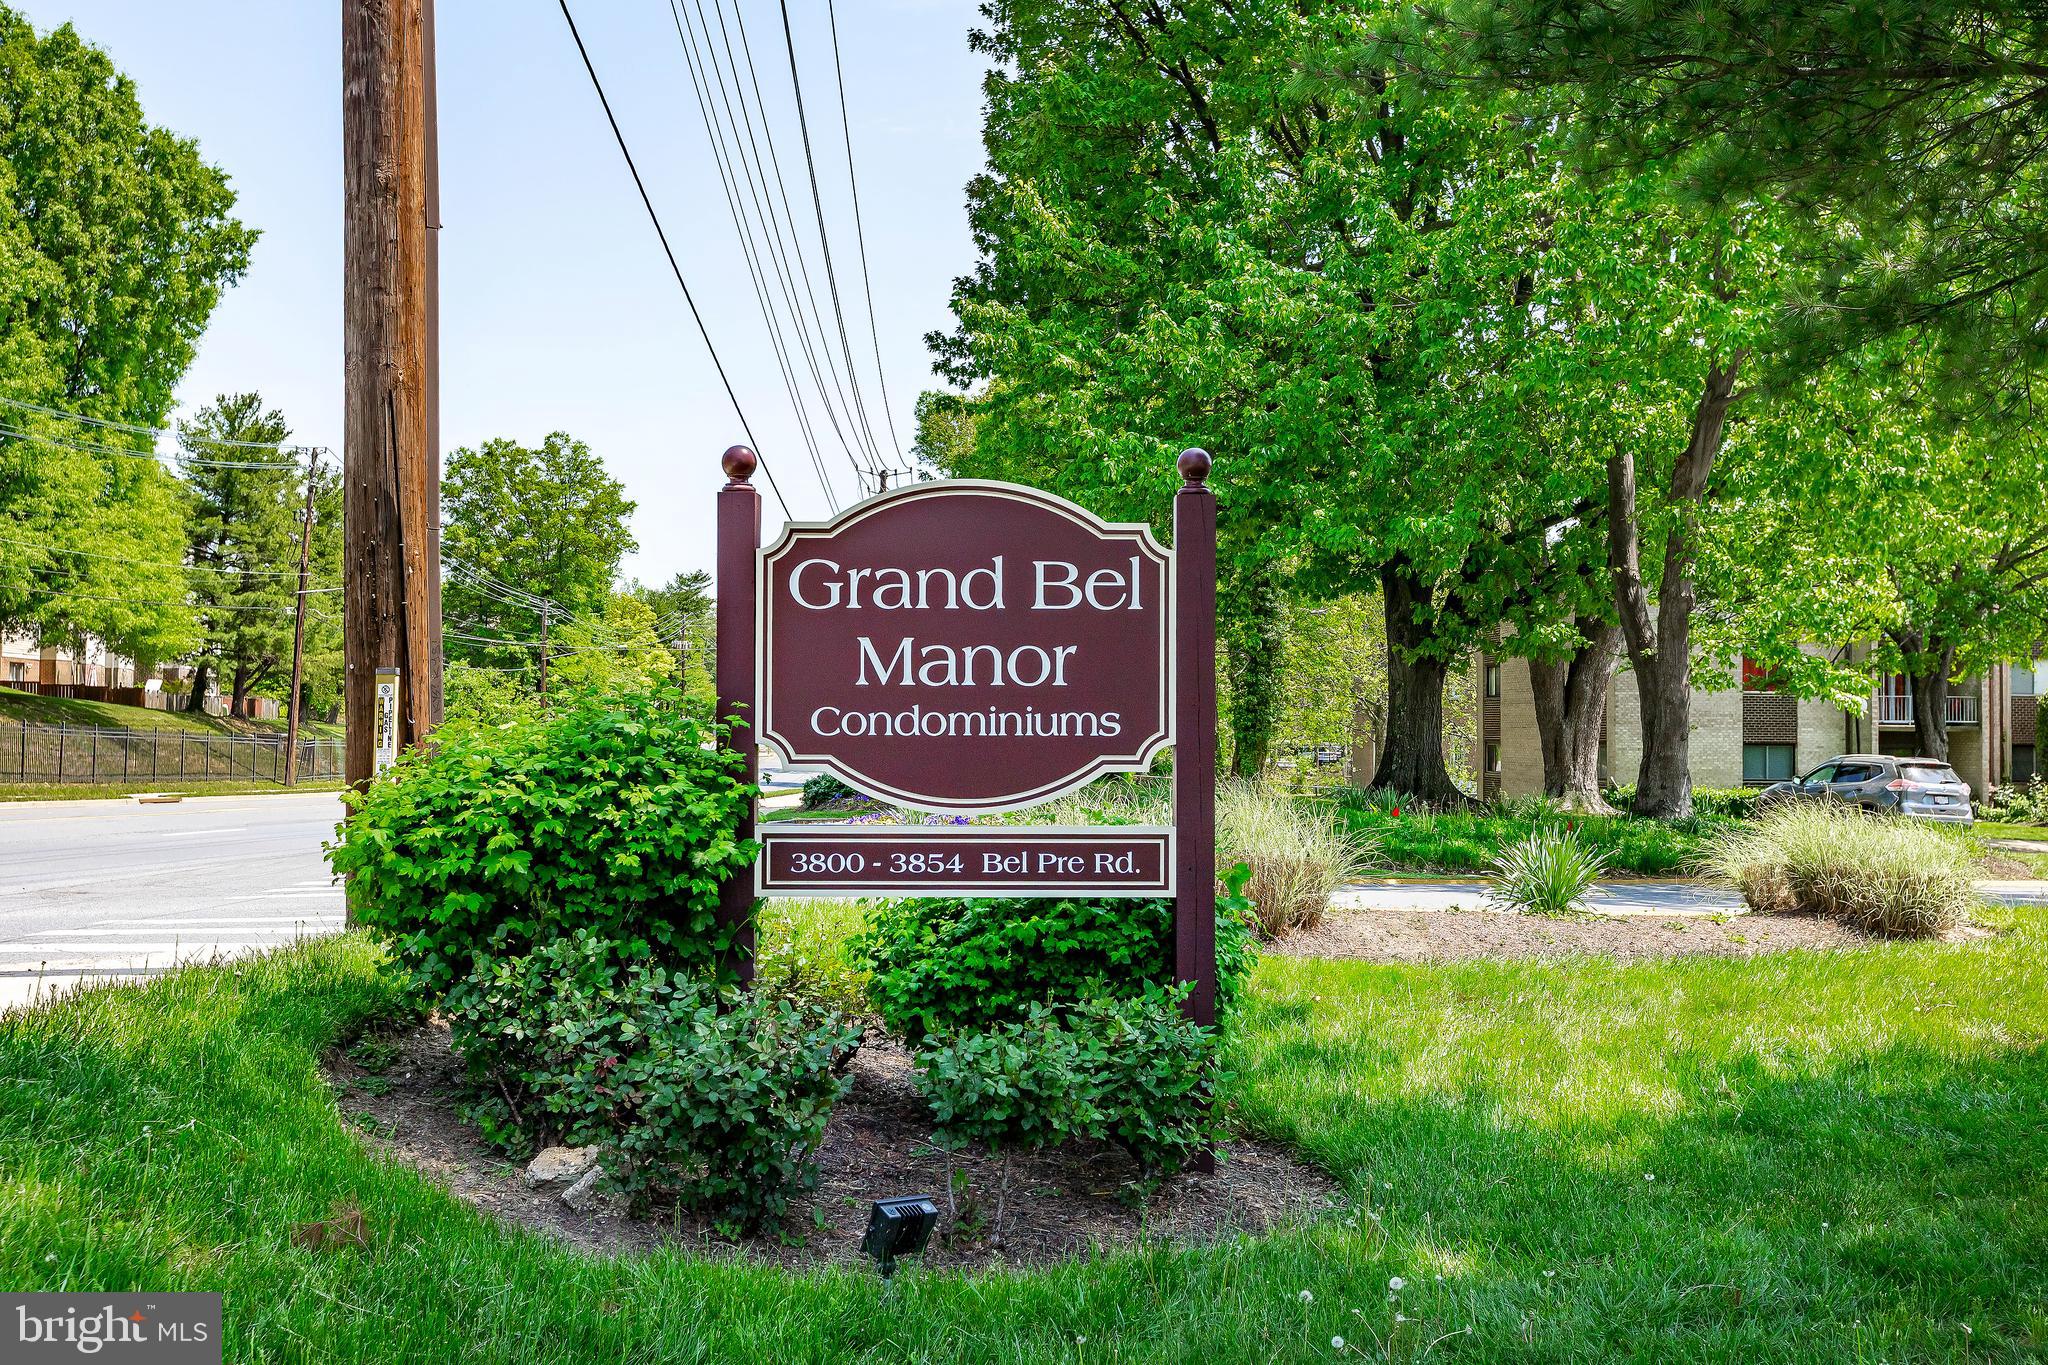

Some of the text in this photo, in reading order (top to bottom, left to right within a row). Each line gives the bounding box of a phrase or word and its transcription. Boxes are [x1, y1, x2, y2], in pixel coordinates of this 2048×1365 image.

[788, 555, 1144, 611] Grand Bel
[855, 636, 1078, 687] Manor
[810, 703, 1122, 737] Condominiums
[790, 852, 865, 874] 3800
[889, 852, 965, 874] 3854
[981, 850, 1029, 874] Bel
[1037, 853, 1085, 874] Pre
[1093, 851, 1141, 874] Rd.
